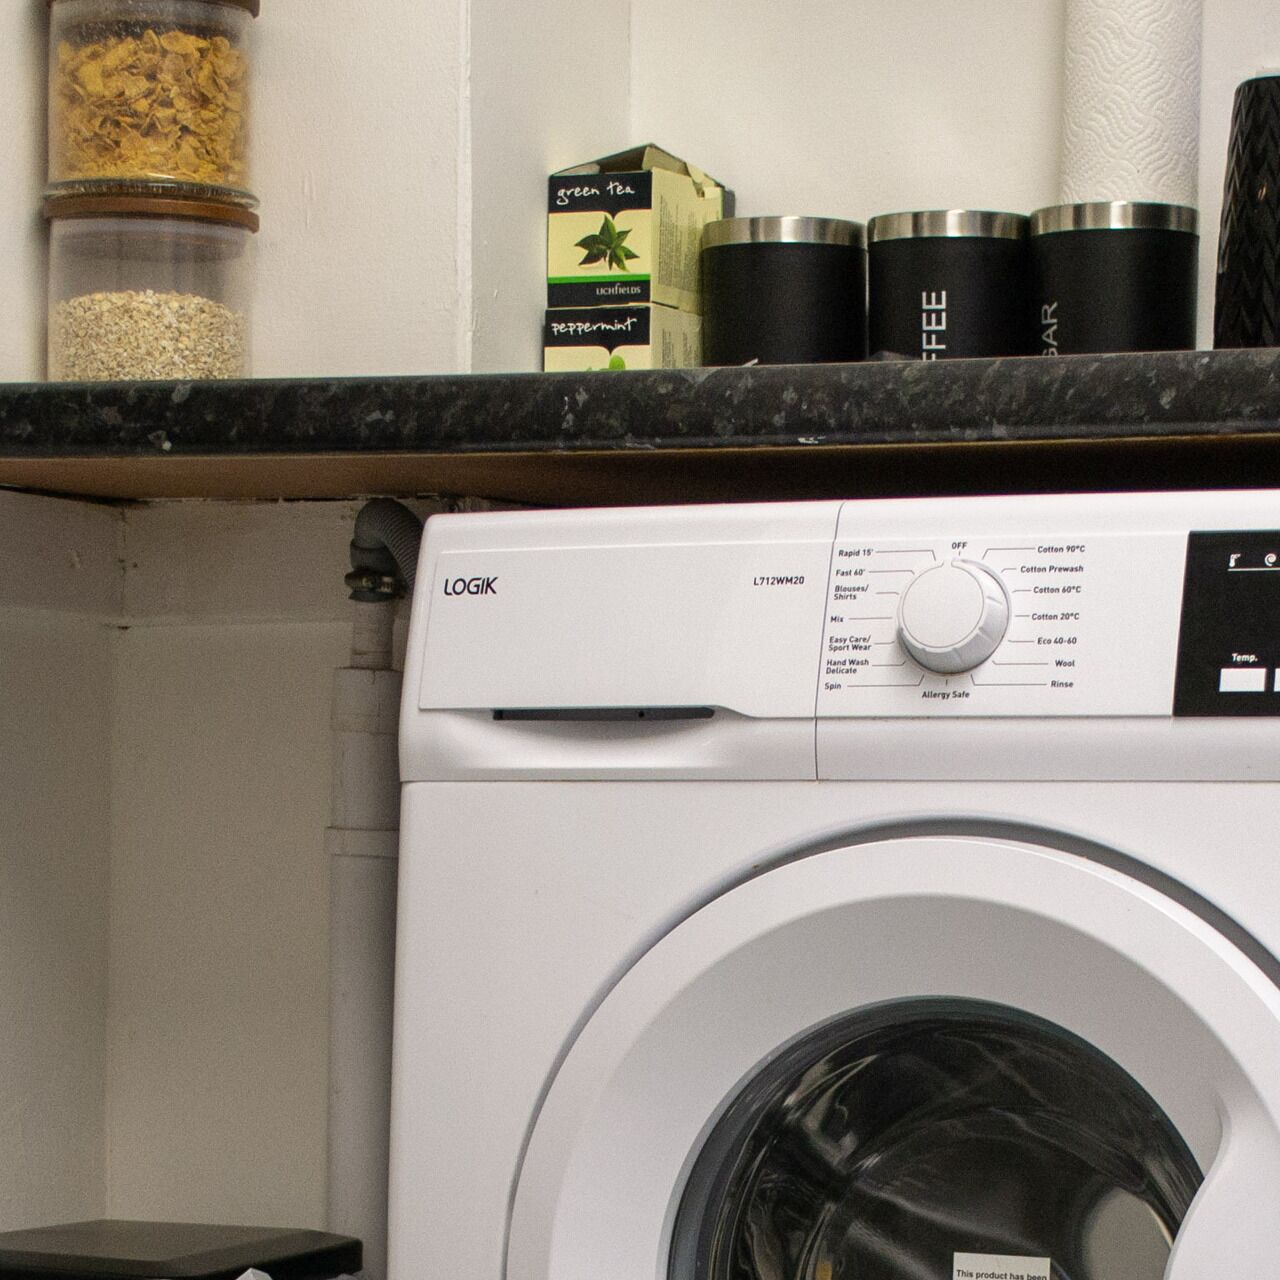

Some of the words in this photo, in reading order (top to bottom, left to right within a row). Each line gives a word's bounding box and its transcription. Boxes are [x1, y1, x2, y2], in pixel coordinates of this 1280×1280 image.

[556, 185, 600, 206] green
[606, 181, 635, 196] tea
[551, 316, 638, 336] peppermint
[951, 541, 968, 550] OFF
[1037, 546, 1064, 554] Cotton
[1066, 545, 1086, 553] 90°C
[838, 549, 860, 558] Rapid
[1020, 565, 1047, 573] Cotton
[1049, 564, 1084, 573] Prewash
[753, 576, 805, 586] L712WM20
[444, 577, 498, 596] LOGIK
[834, 584, 869, 593] Blouses/
[1033, 586, 1060, 594] Cotton
[1061, 585, 1081, 593] 60°C
[833, 593, 857, 601] Shirts
[830, 615, 844, 623] Mix
[1032, 613, 1058, 621] Cotton
[1060, 612, 1080, 620] 20°C
[829, 636, 848, 644] Easy
[849, 635, 871, 643] Care/
[1037, 637, 1052, 645] Eco
[1053, 637, 1077, 645] 40-60
[828, 644, 850, 652] Sport
[848, 658, 869, 666] Wash
[1232, 653, 1258, 662] Temp.
[1055, 659, 1075, 667] Wool
[825, 666, 857, 674] Delicate
[824, 682, 842, 691] Spin
[1051, 680, 1074, 688] Rinse
[922, 690, 950, 700] Allergy
[952, 690, 970, 698] Safe
[956, 1269, 974, 1278] This
[975, 1271, 1008, 1280] product
[1009, 1273, 1025, 1280] has
